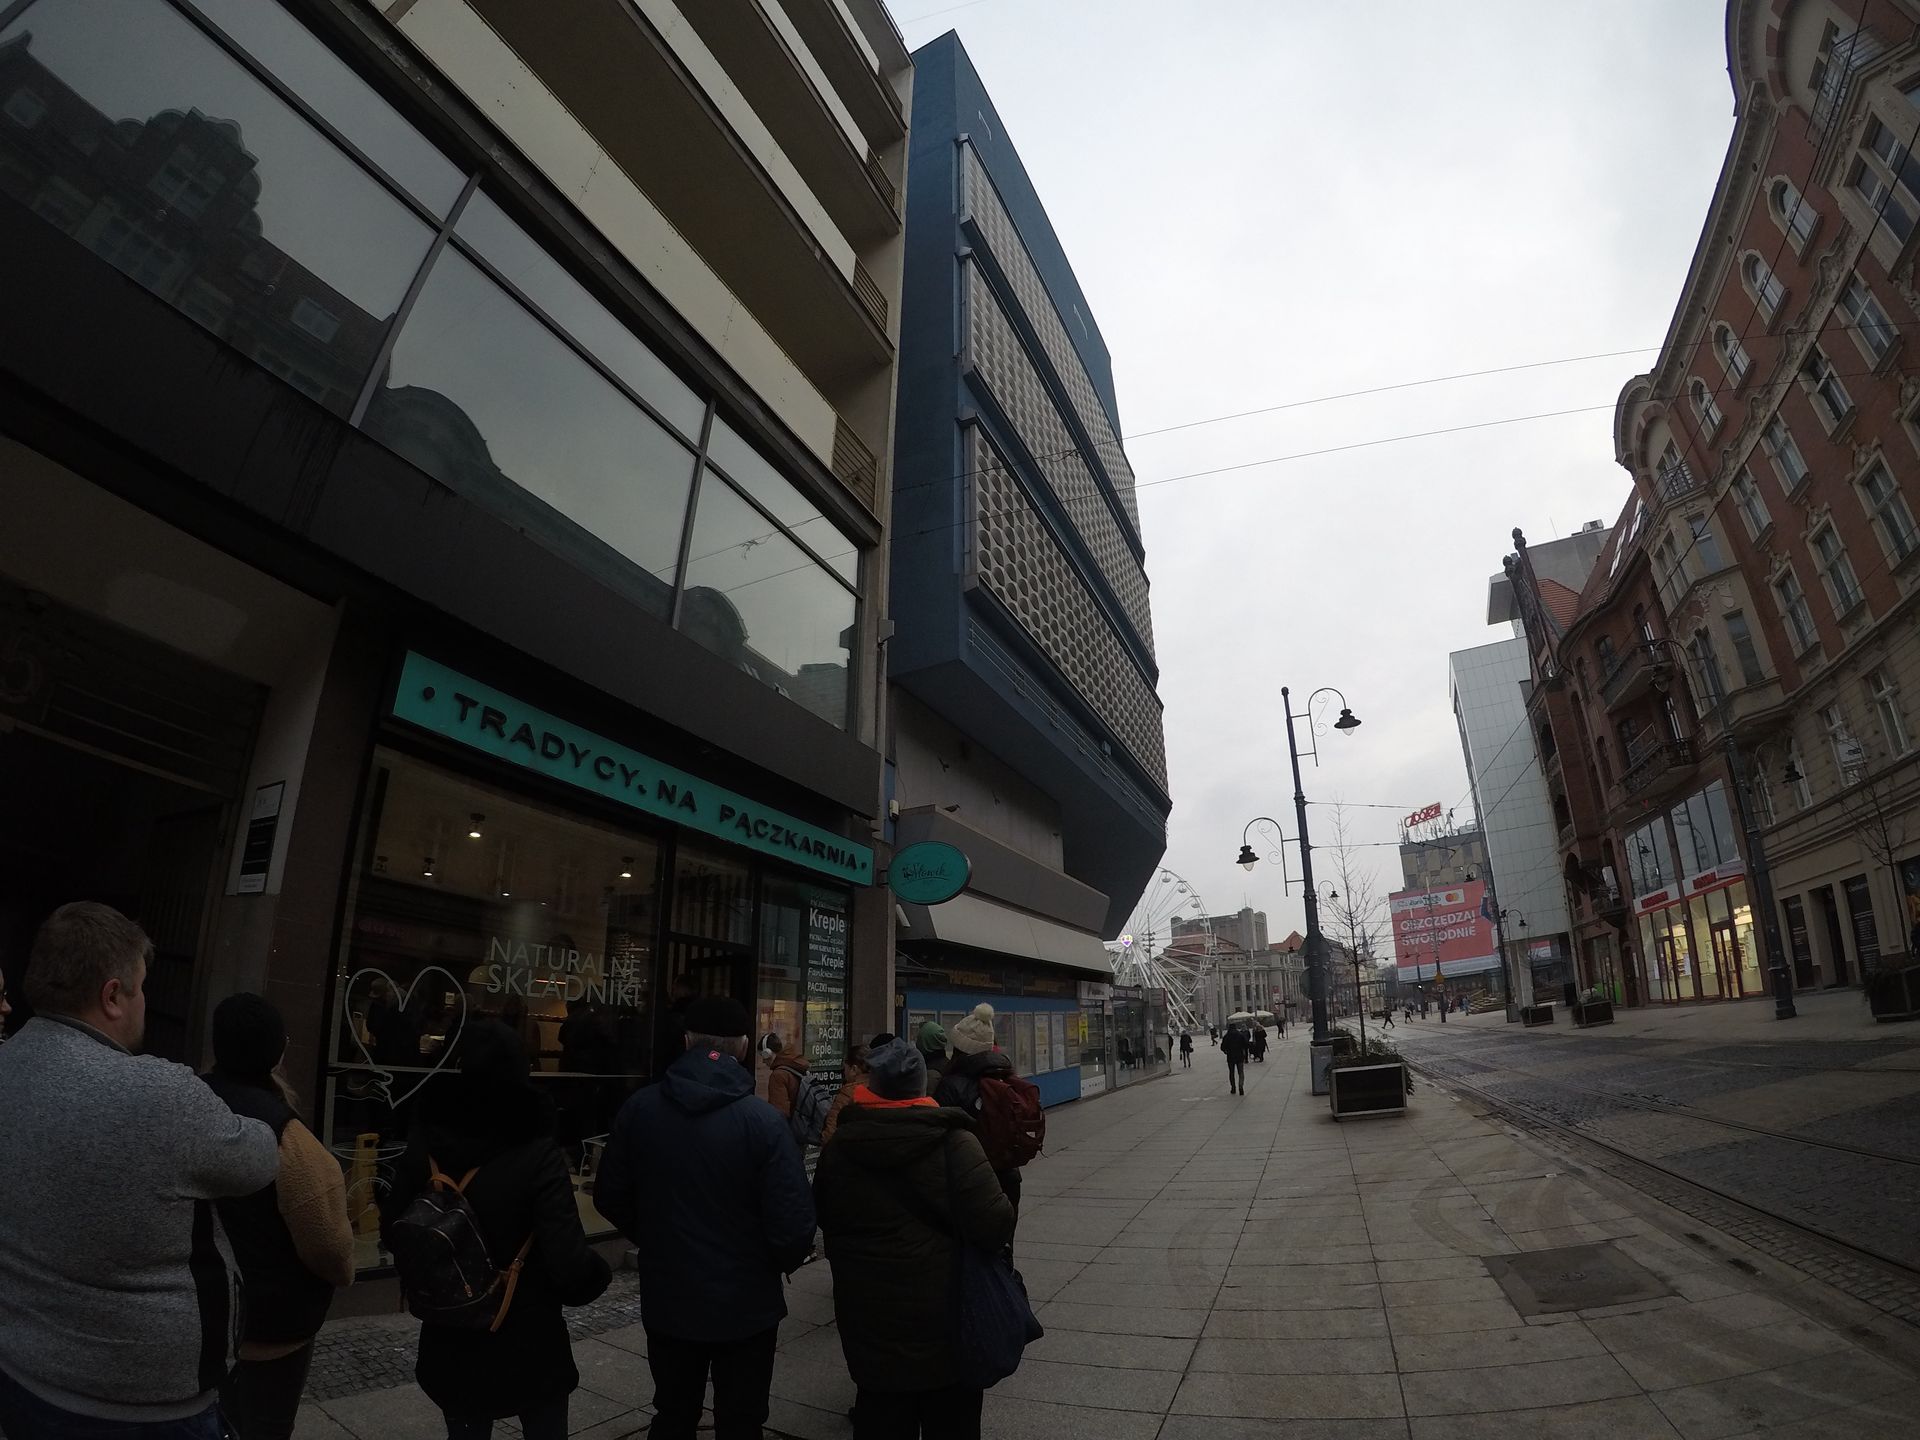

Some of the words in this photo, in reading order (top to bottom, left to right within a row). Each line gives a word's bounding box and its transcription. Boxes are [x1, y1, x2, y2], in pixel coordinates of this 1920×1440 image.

[454, 692, 698, 812] TRADYCYNA
[719, 803, 857, 870] PĄCZKARNIA
[809, 907, 845, 935] Kreple
[1402, 926, 1476, 946] SWOODNIE
[490, 936, 641, 978] NATURALNE
[821, 953, 844, 970] Kreple
[486, 964, 642, 1008] SKŁADNIKI
[818, 1027, 843, 1041] PĄCZKI
